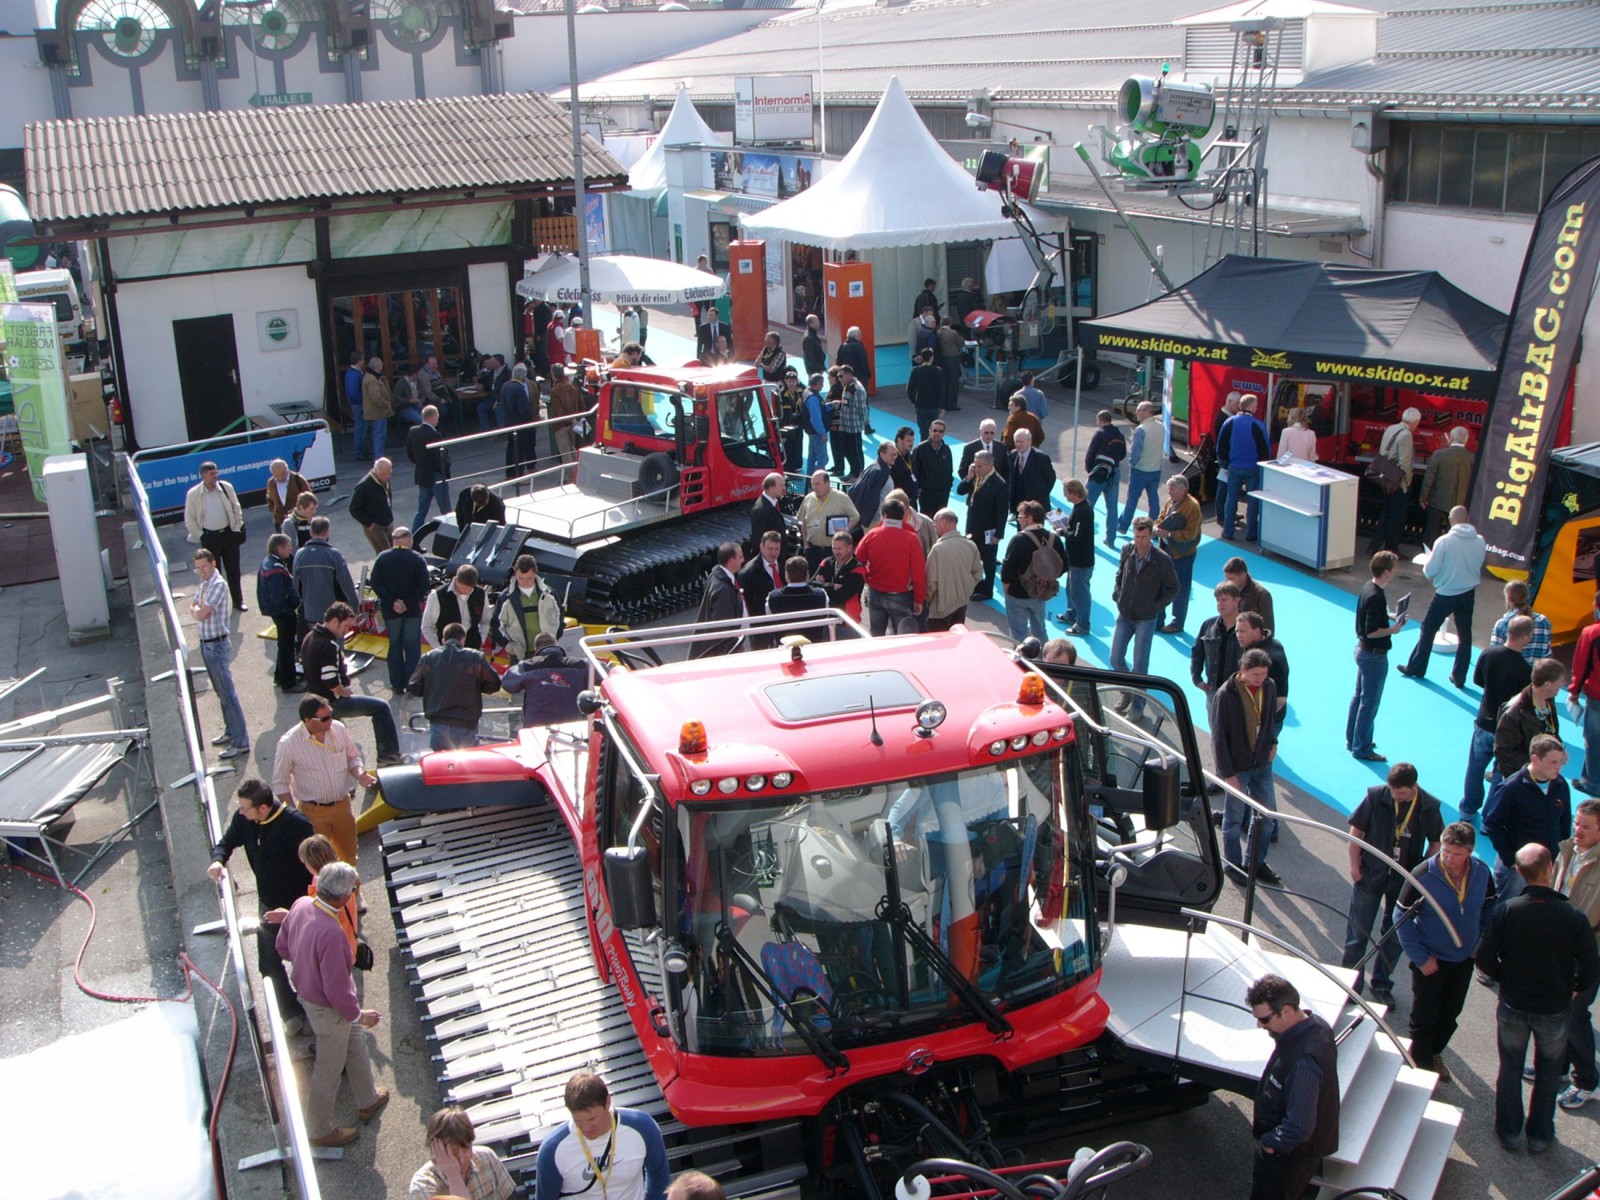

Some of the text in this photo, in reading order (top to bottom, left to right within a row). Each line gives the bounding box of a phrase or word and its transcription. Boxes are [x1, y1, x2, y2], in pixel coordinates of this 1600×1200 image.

[264, 95, 297, 105] HALLE
[755, 96, 804, 106] Internorm
[616, 293, 671, 304] Pflück dir eins!
[1099, 334, 1229, 361] www.skidoo-x.at
[1488, 201, 1586, 527] BigAirBAG.com
[1315, 361, 1471, 391] www.skidoo-x.at
[153, 479, 164, 489] for
[164, 477, 177, 487] the
[177, 475, 190, 485] top
[309, 478, 331, 489] BECO
